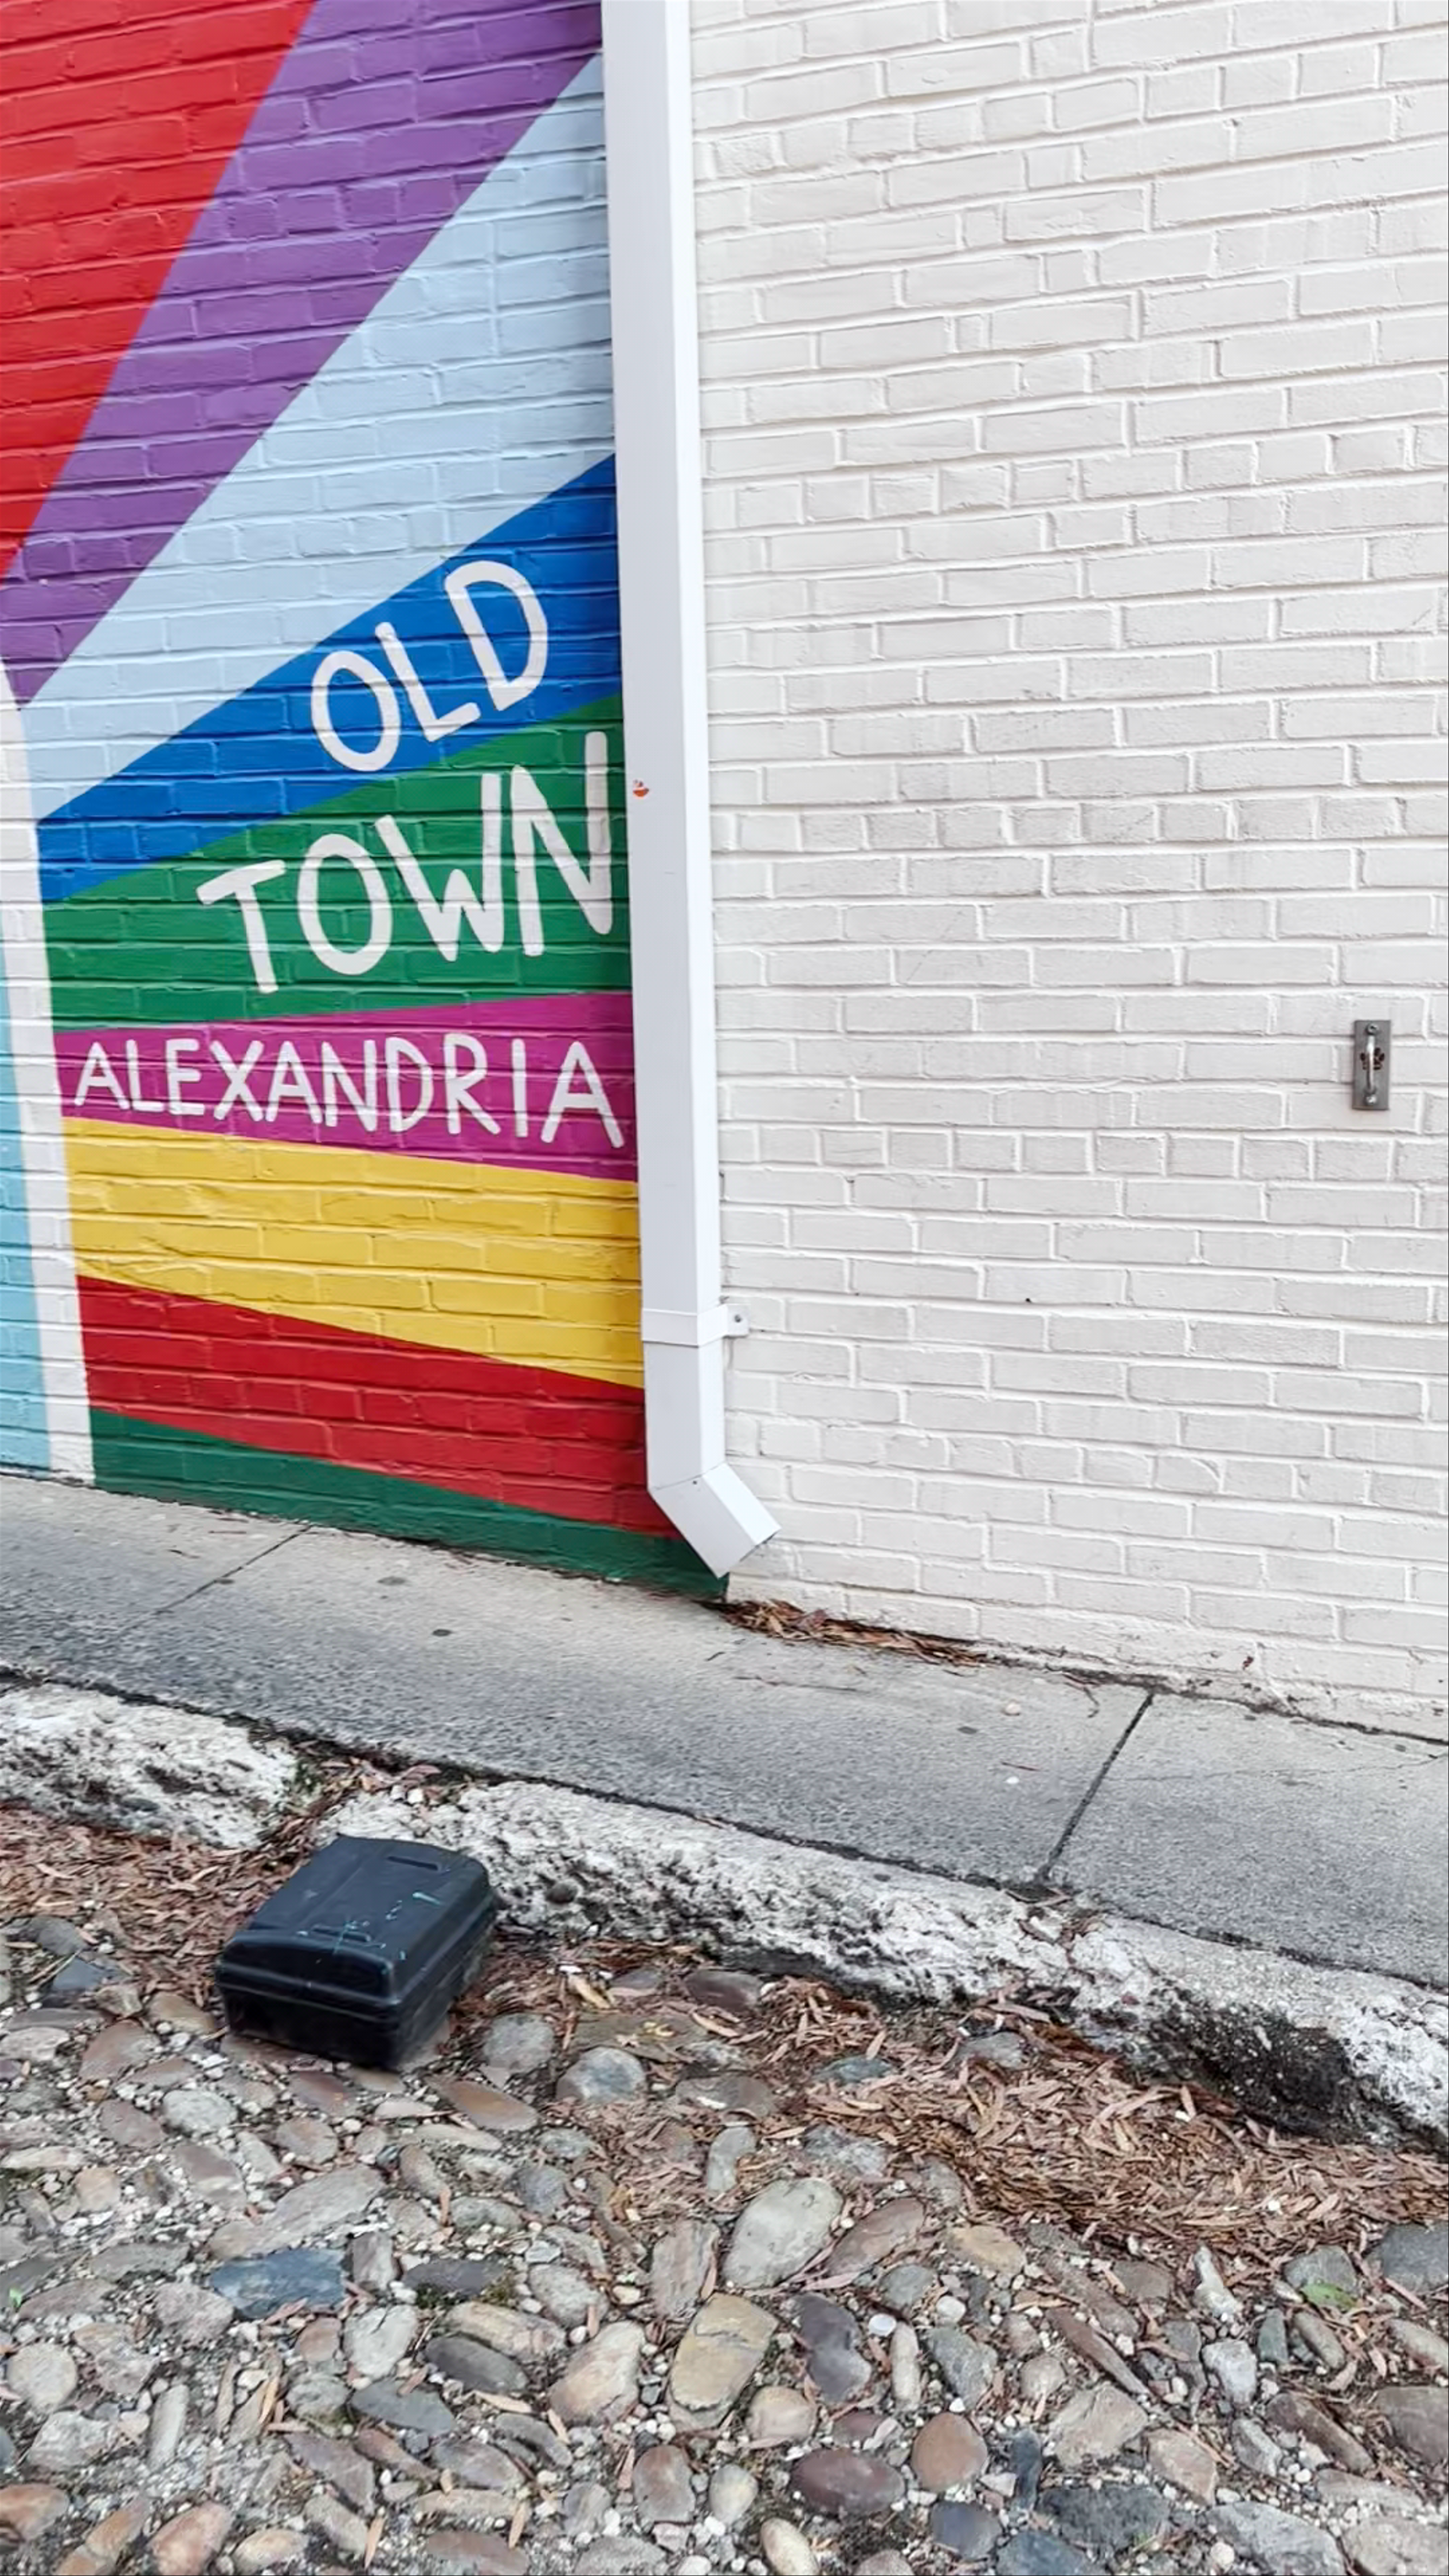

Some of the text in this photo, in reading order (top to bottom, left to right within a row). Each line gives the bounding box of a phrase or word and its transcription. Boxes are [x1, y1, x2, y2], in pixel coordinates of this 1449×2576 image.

[311, 560, 548, 771] OLD
[196, 731, 613, 993] TOWN
[74, 1032, 625, 1148] ALEXANDRIA
